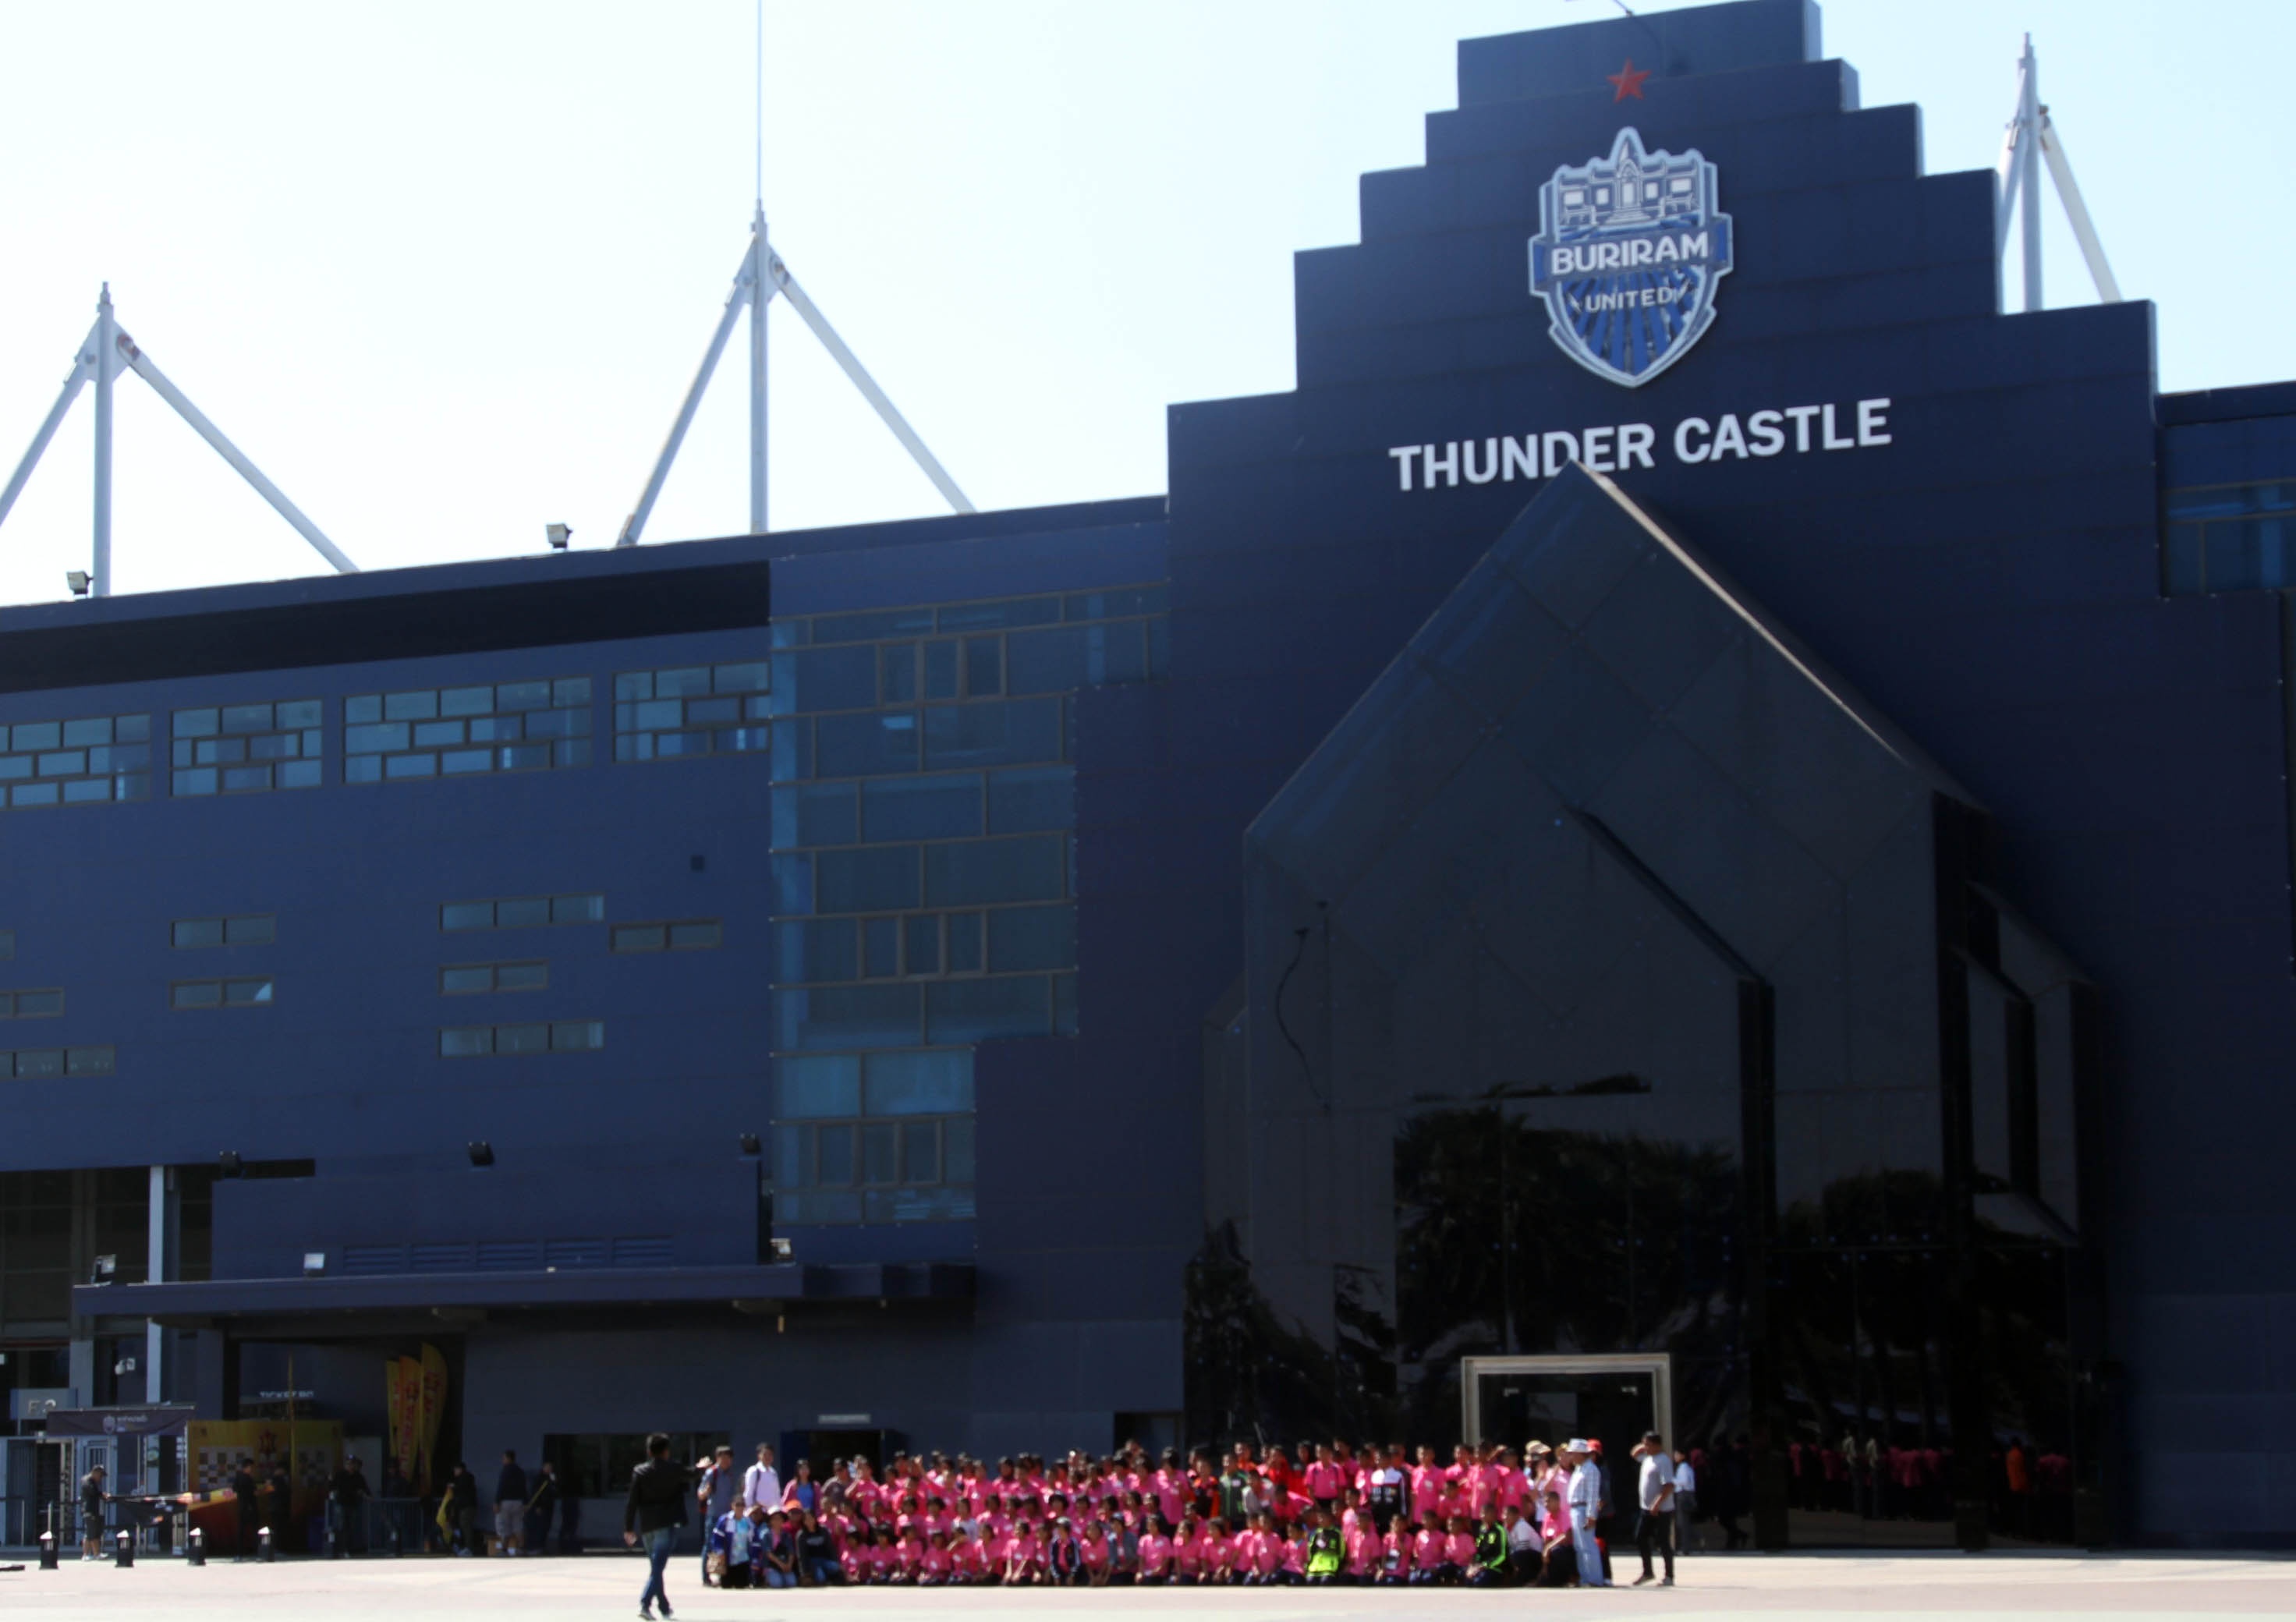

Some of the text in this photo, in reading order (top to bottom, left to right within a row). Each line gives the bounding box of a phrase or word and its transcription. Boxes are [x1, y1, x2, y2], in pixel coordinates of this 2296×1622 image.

[1551, 232, 1709, 275] BURIRAM
[1584, 286, 1674, 312] UNITED
[1388, 398, 1893, 491] THUNDER CASTLE
